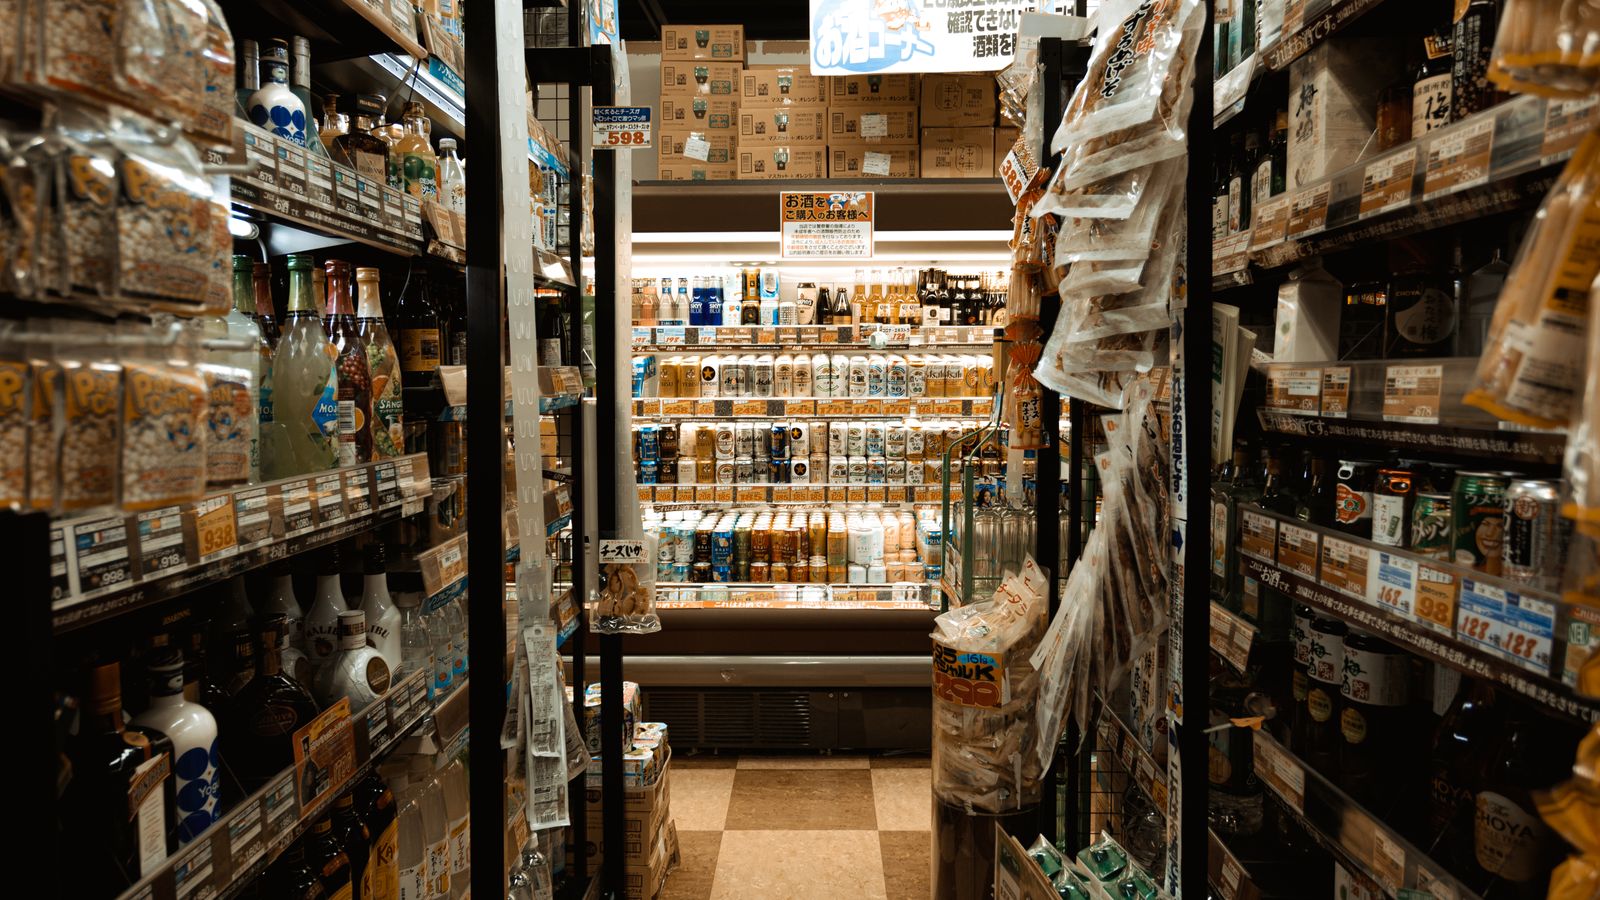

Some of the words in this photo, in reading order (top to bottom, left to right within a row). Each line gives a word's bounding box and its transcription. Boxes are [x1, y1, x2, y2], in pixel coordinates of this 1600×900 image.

[814, 13, 935, 68] お酒コーナー
[608, 131, 644, 145] 598
[1002, 160, 1022, 196] 388
[785, 194, 826, 208] お酒を
[785, 209, 868, 220] ご購入のお客様へ
[1514, 496, 1539, 520] 新
[204, 524, 233, 548] 938
[160, 553, 180, 568] 918
[601, 544, 643, 557] チーズいか
[101, 569, 126, 586] 998
[714, 600, 773, 608] これはお酒です。
[1377, 585, 1402, 606] 168
[1419, 596, 1449, 624] 98
[1459, 615, 1490, 642] 128
[1502, 631, 1537, 659] 128
